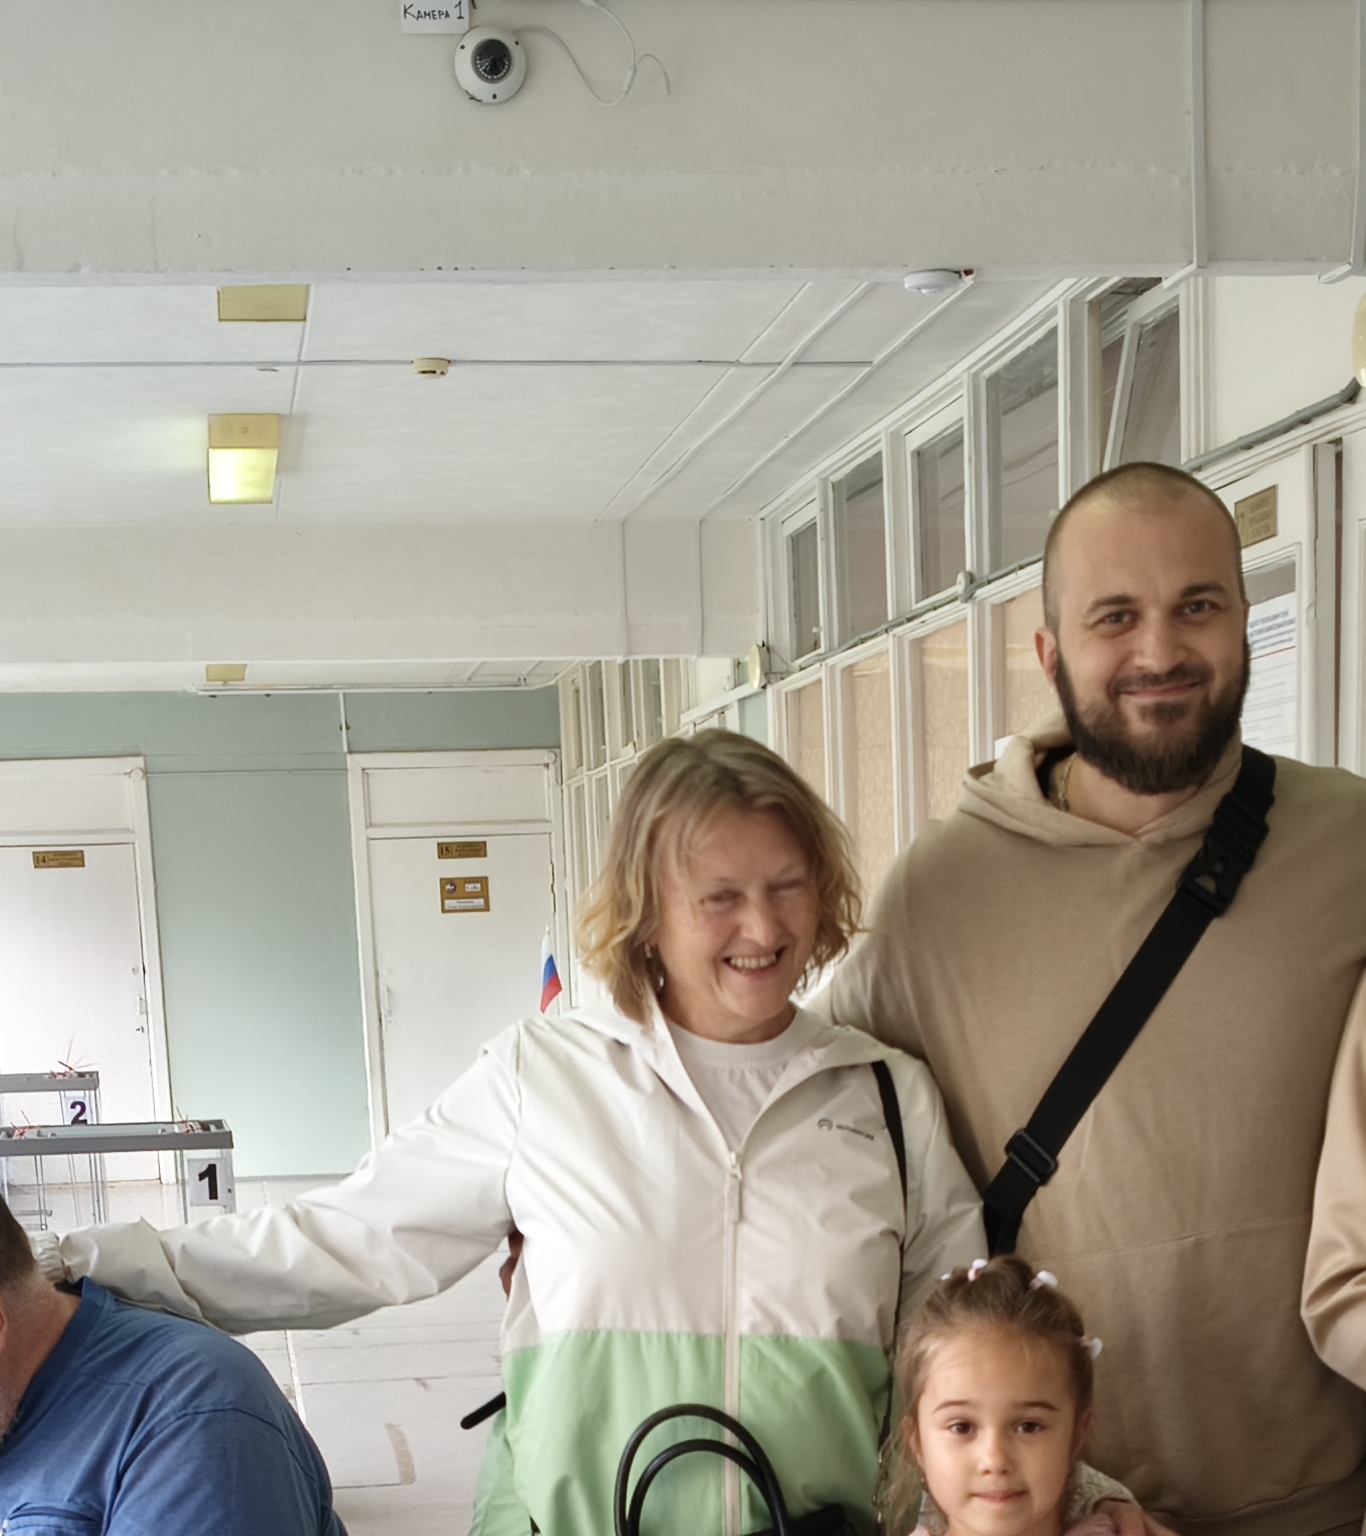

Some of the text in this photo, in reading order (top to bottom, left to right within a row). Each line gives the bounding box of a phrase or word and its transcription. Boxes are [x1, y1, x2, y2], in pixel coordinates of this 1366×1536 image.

[454, 0, 464, 19] 1
[70, 1101, 87, 1125] 2
[198, 1163, 218, 1200] 1
